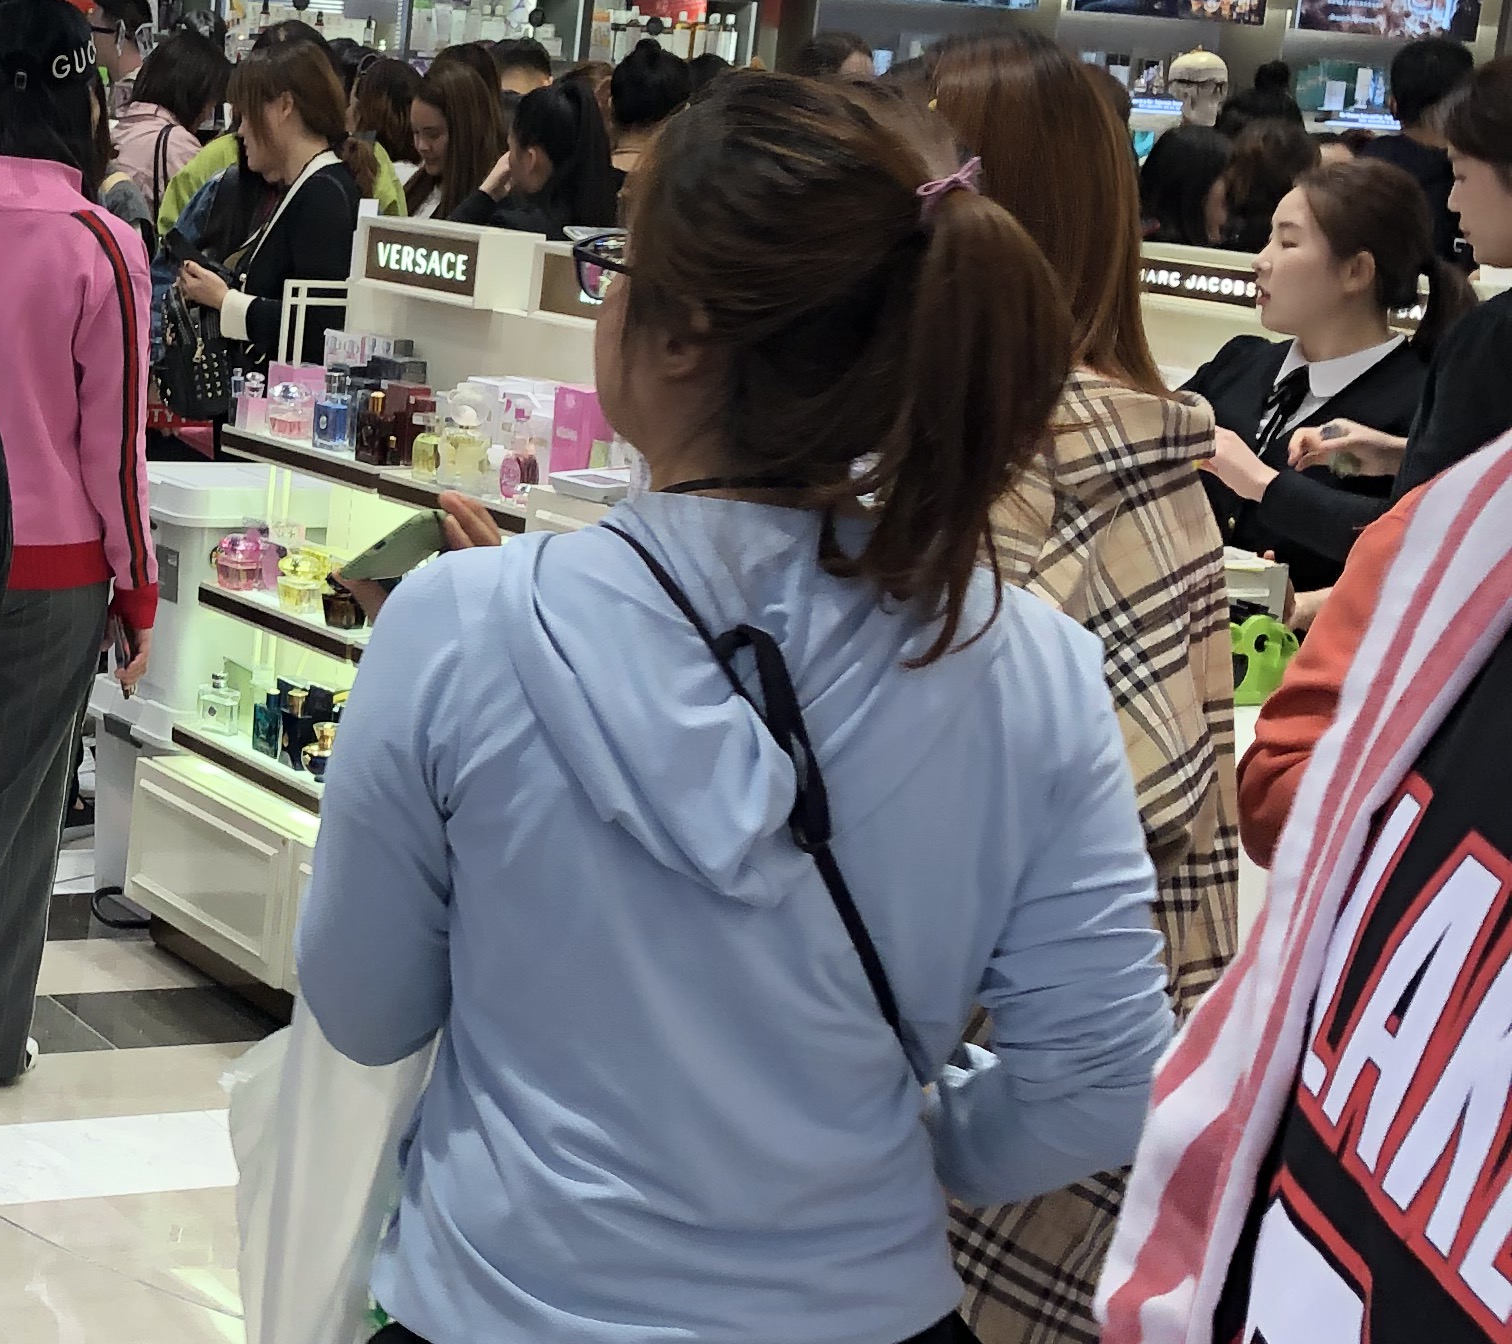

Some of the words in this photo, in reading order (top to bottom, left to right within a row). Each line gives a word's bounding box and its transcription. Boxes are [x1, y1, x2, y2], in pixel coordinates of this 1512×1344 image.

[52, 32, 97, 79] GUC
[376, 241, 469, 282] VERSACE
[1185, 274, 1257, 298] JACOBS
